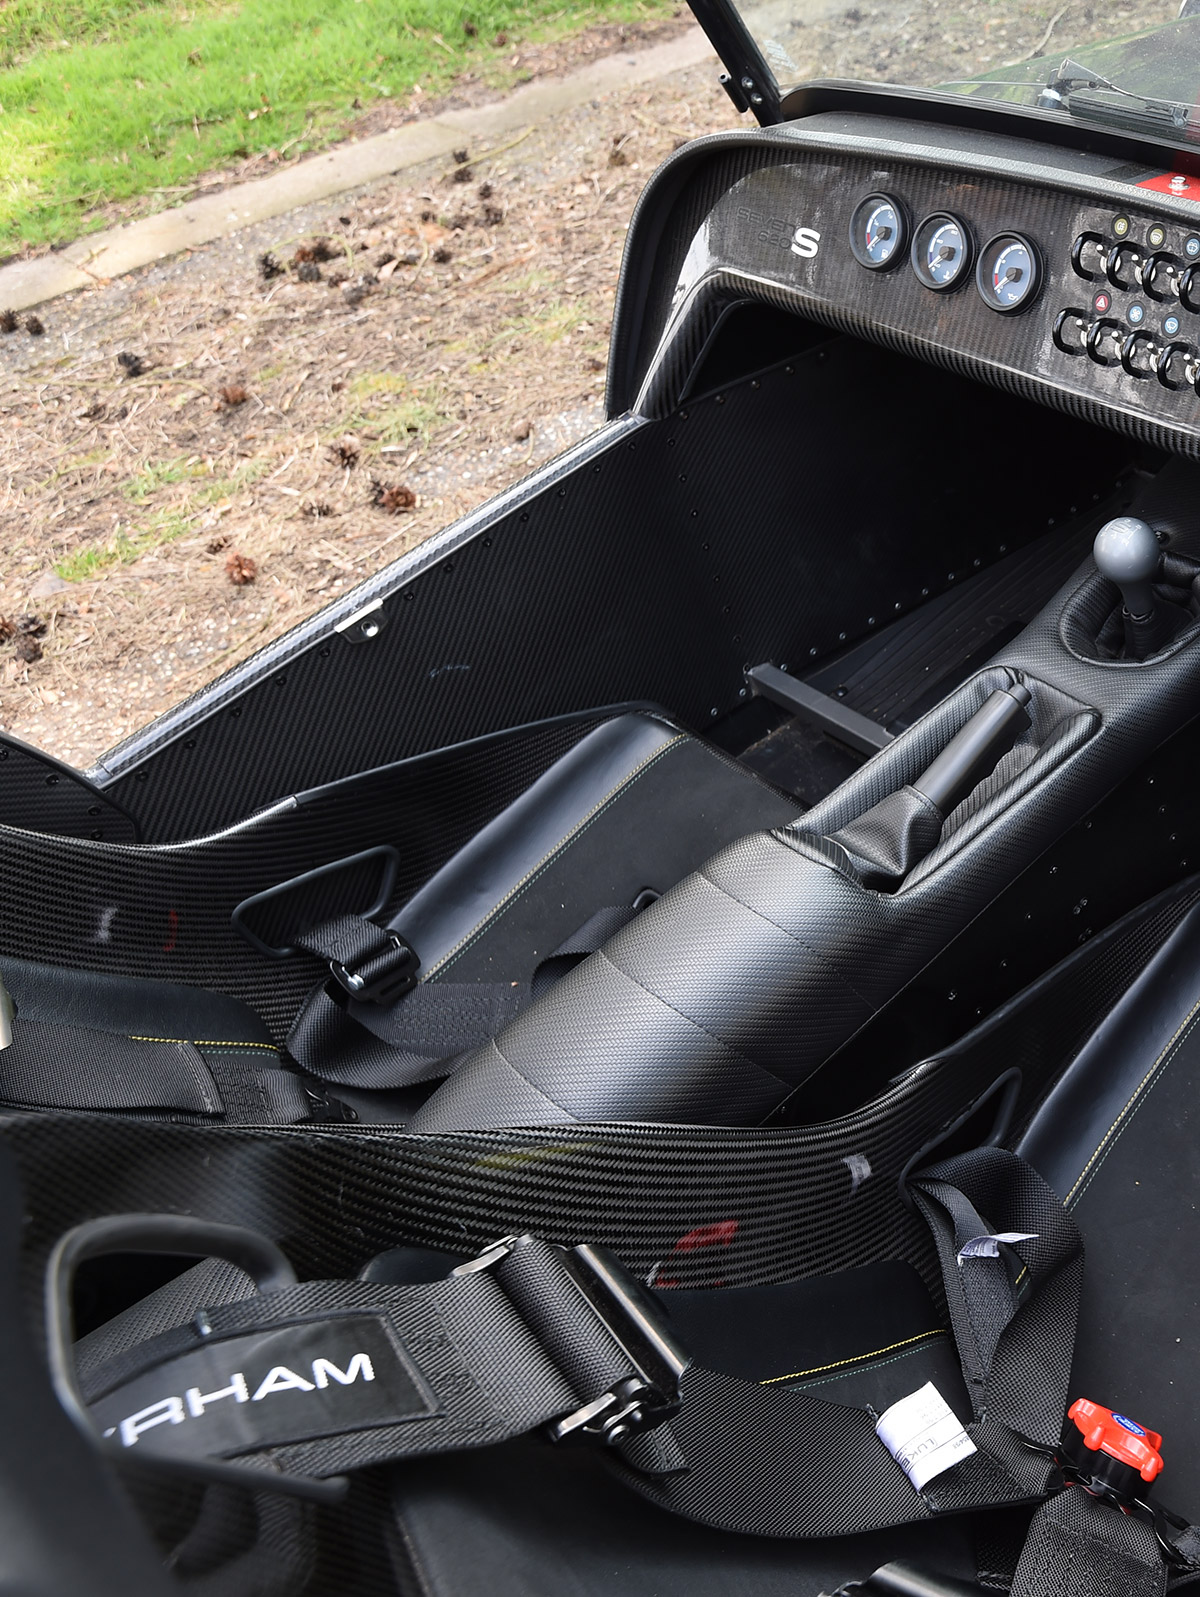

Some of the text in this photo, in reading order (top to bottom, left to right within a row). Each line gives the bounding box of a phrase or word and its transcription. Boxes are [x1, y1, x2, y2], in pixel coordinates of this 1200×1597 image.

[758, 227, 822, 259] 620 S
[103, 1353, 376, 1448] RHAM
